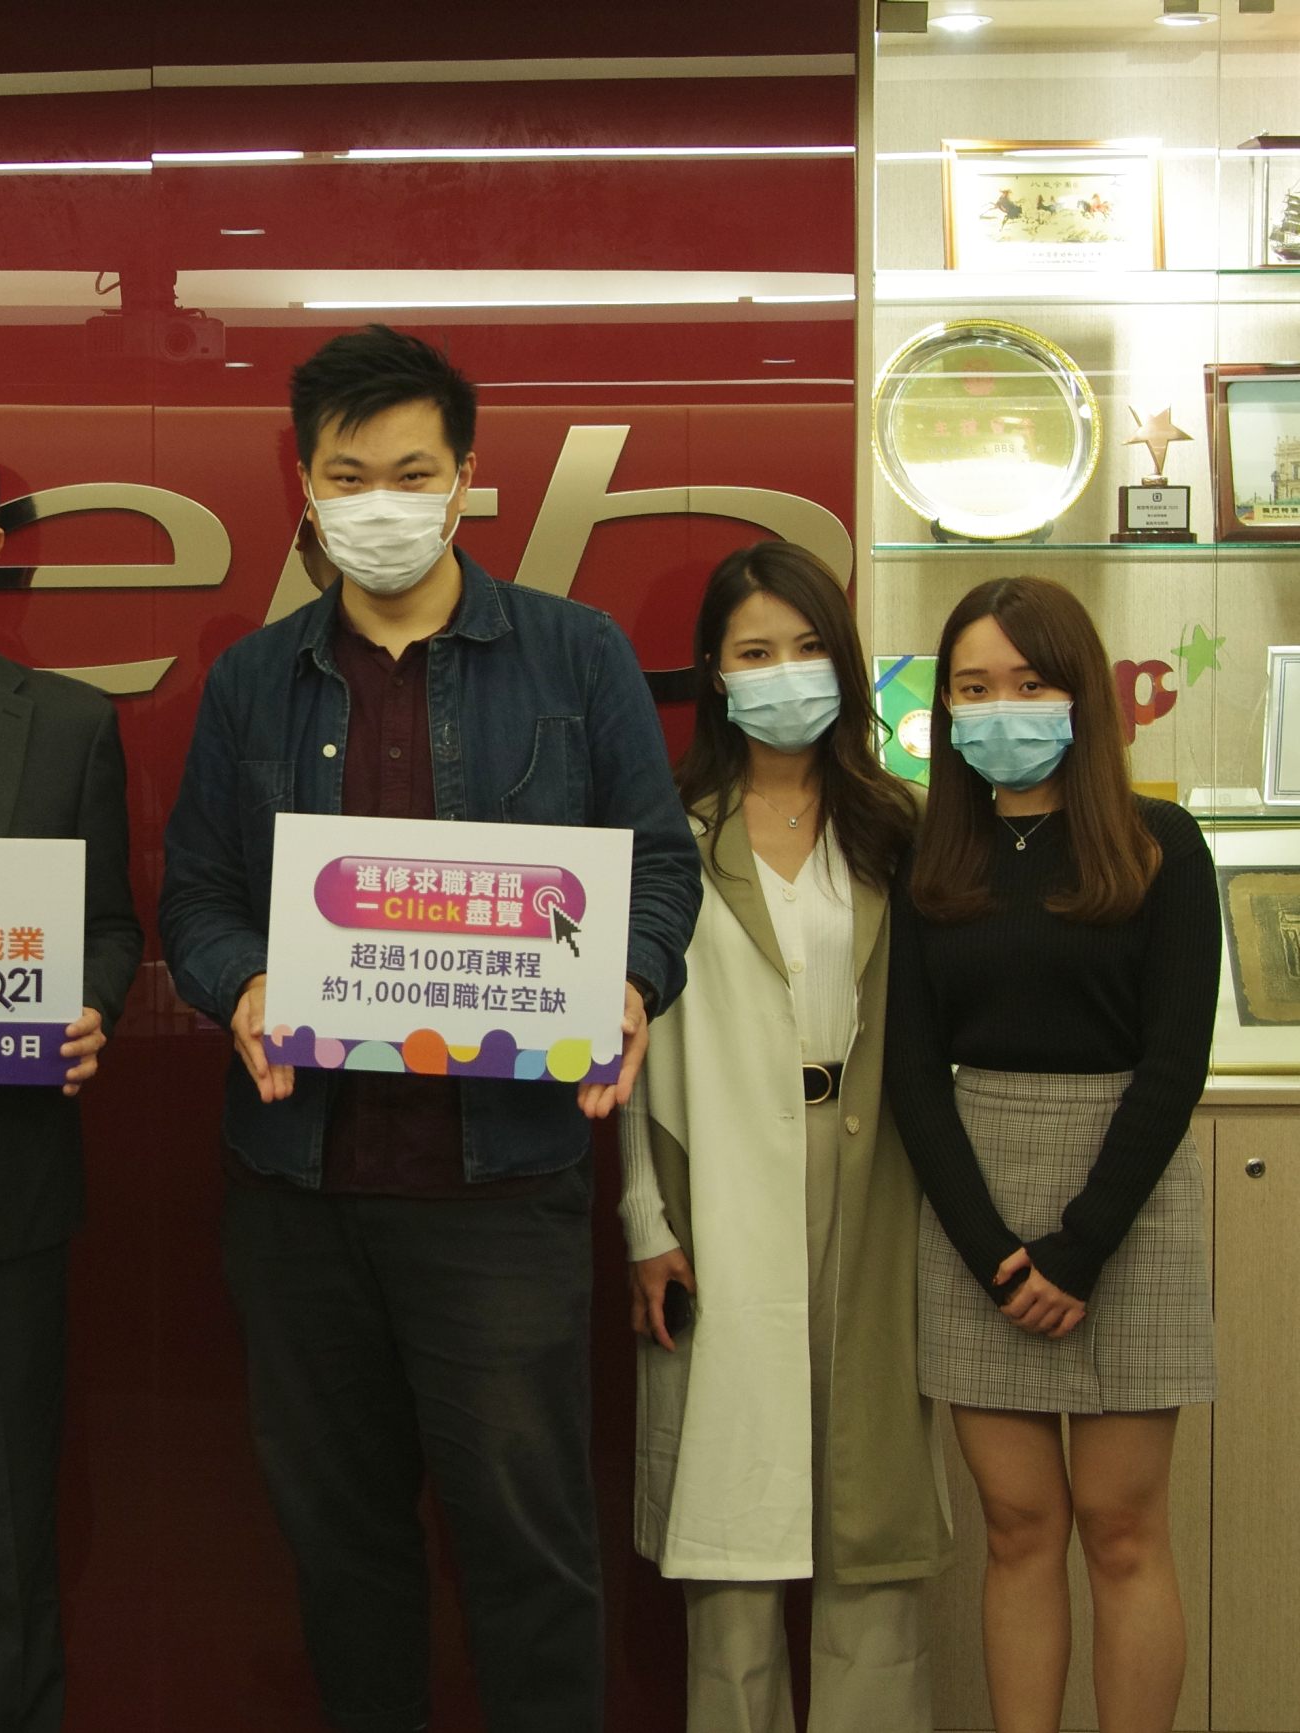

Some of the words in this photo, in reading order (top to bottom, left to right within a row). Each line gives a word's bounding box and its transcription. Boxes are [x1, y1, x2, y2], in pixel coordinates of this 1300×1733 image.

[356, 865, 524, 899] 進修求職資訊
[350, 942, 542, 979] 超過100項課程
[321, 975, 567, 1014] 約1,000個職位空缺
